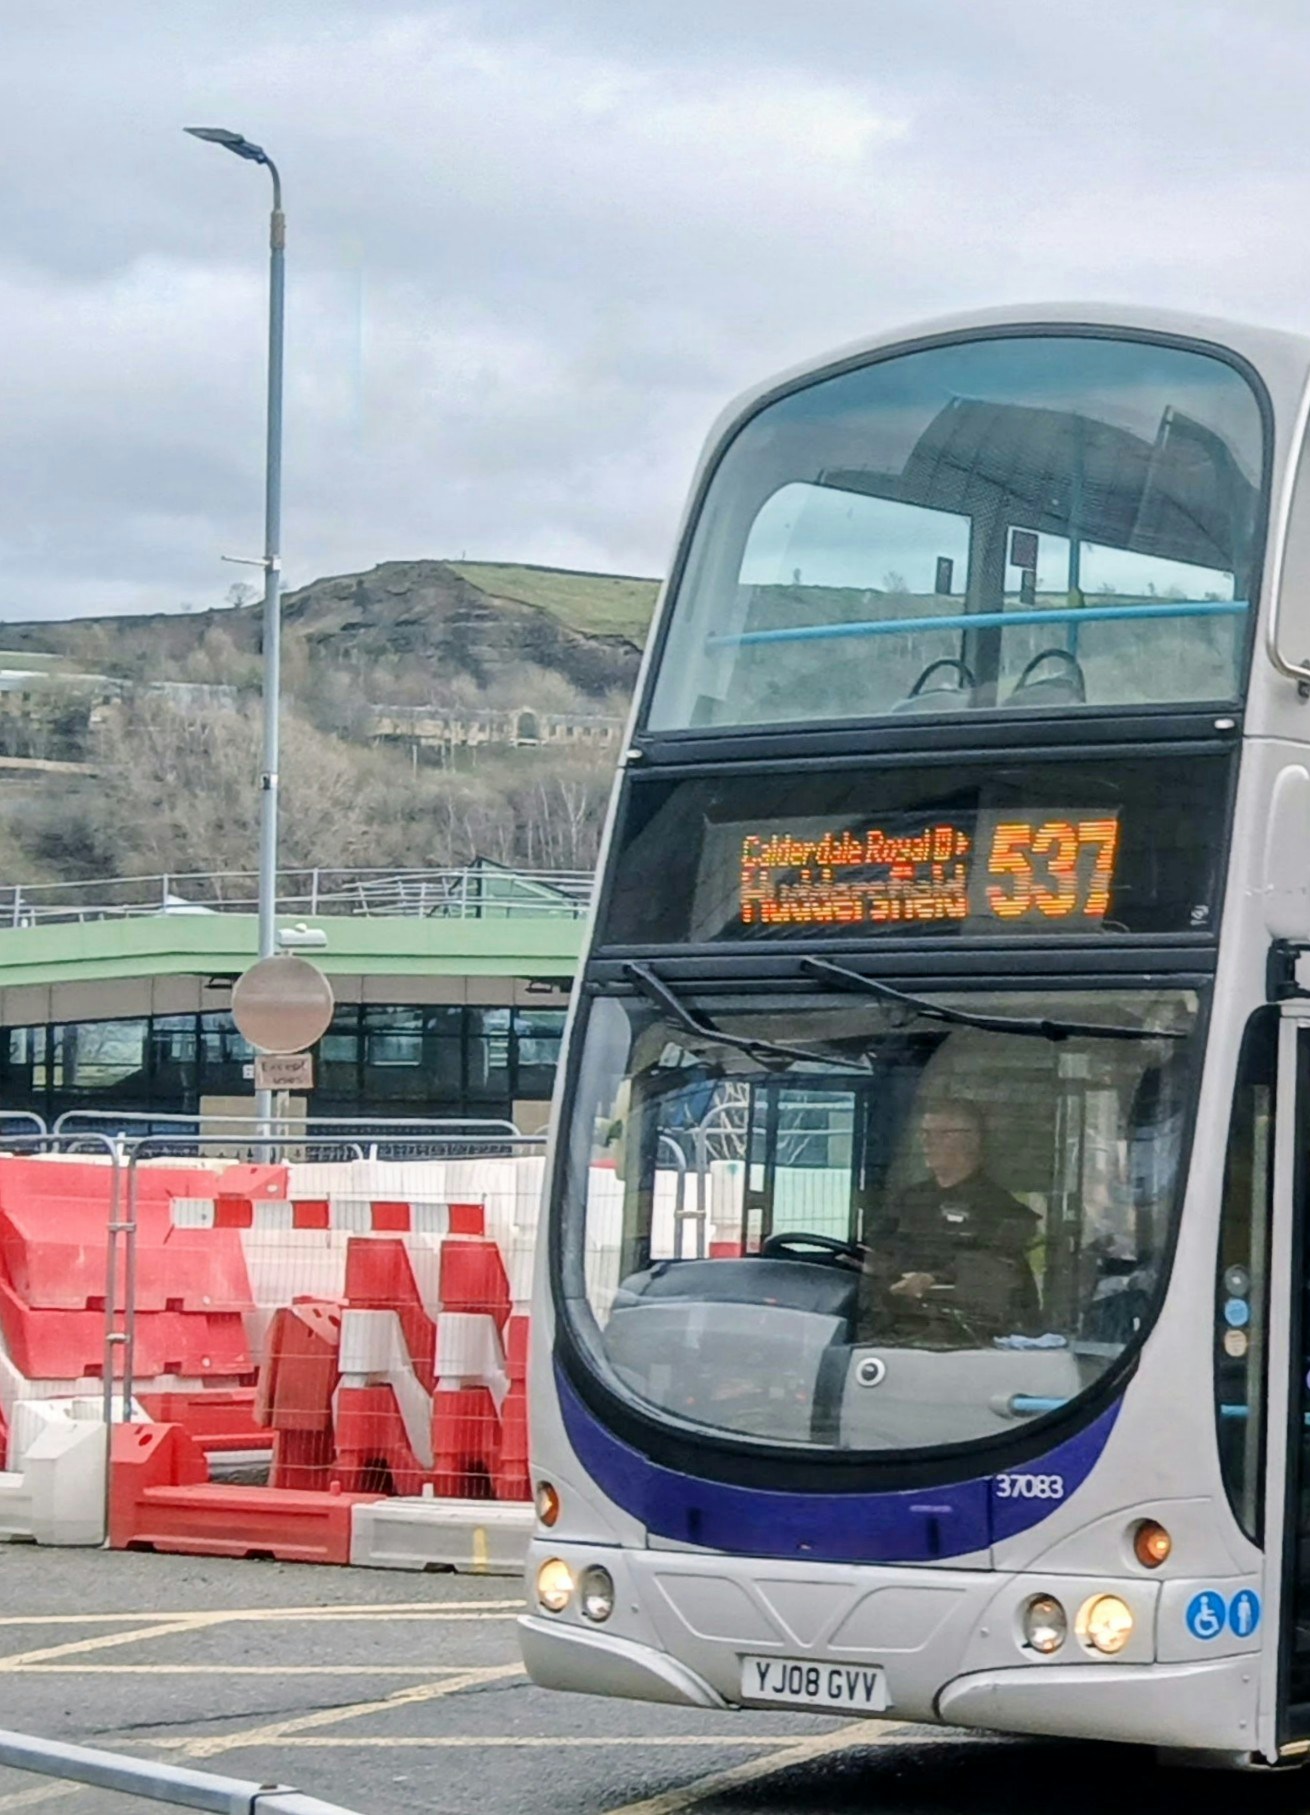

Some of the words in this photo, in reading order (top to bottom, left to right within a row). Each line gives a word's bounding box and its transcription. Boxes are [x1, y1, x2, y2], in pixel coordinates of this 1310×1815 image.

[741, 831, 862, 867] Calderdale
[865, 828, 930, 864] Royal
[985, 818, 1119, 919] 537
[740, 862, 968, 925] Huddersfield
[996, 1474, 1065, 1499] 37083
[756, 1662, 820, 1696] YJ08
[828, 1669, 878, 1702] GVV
